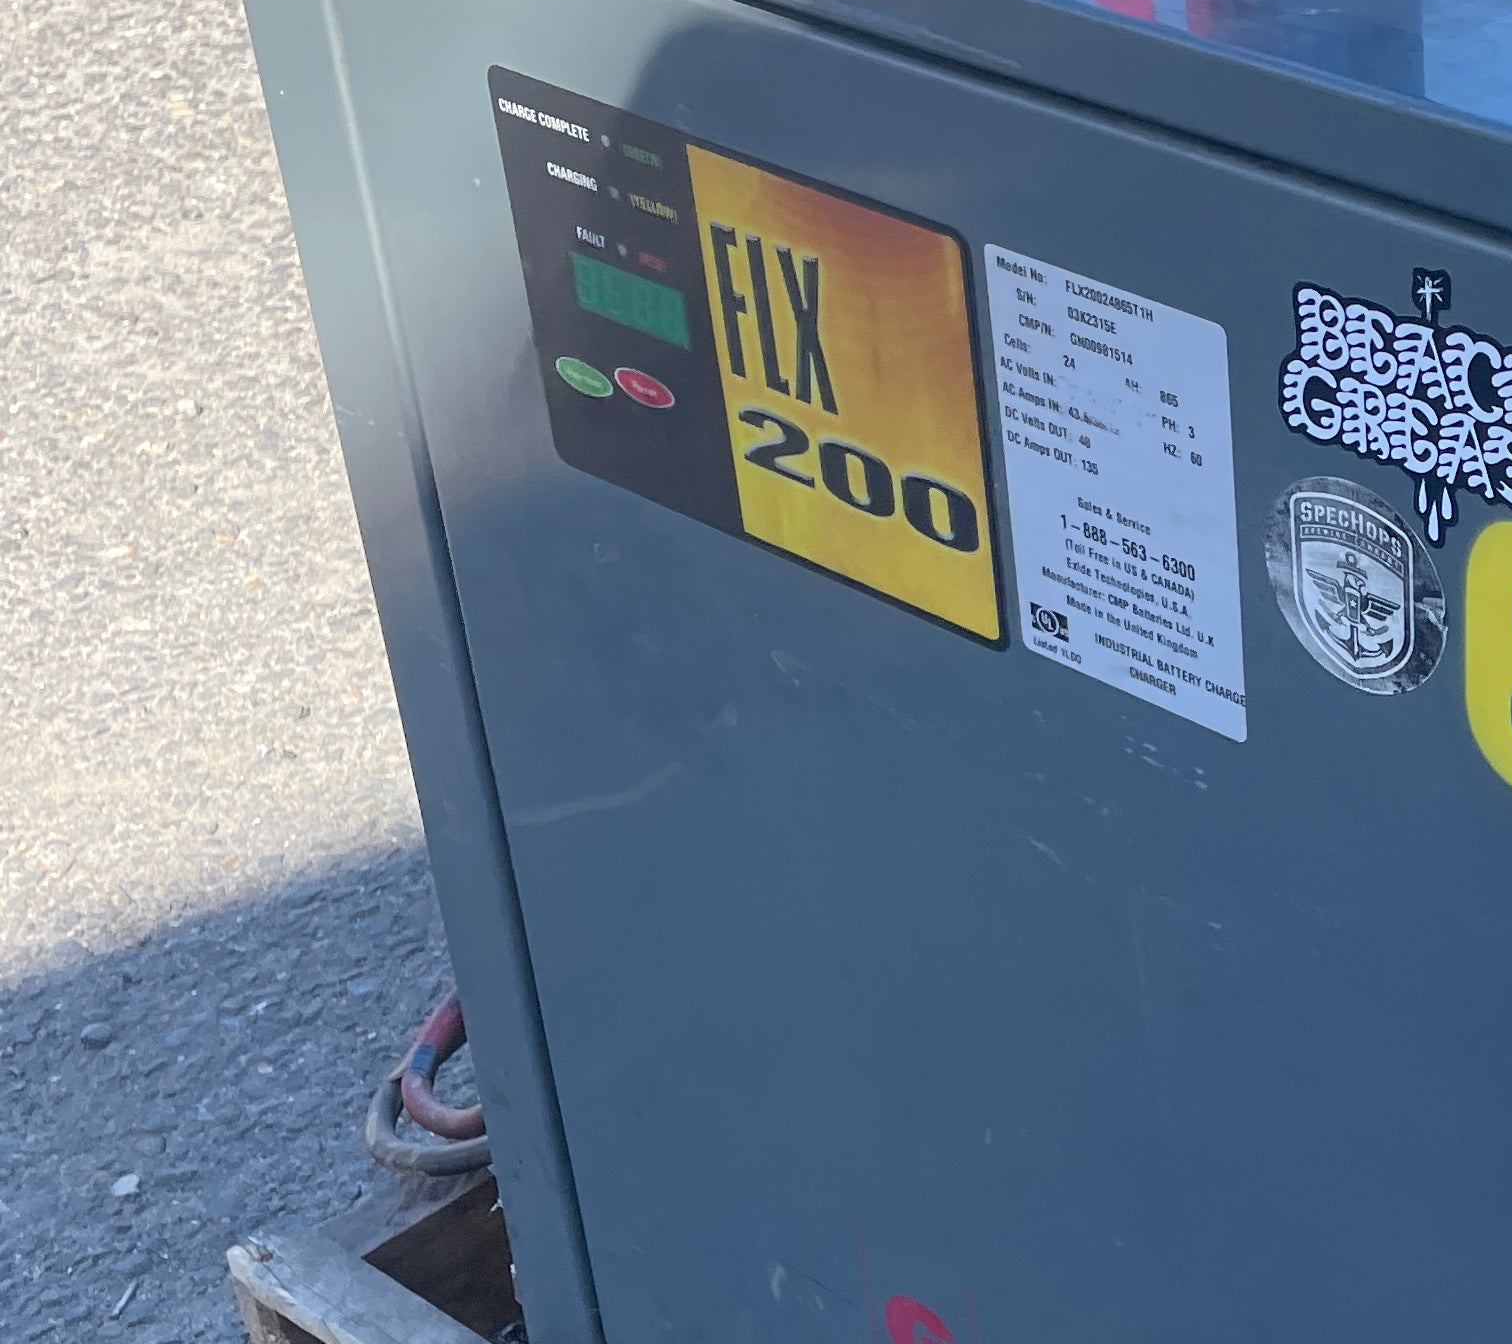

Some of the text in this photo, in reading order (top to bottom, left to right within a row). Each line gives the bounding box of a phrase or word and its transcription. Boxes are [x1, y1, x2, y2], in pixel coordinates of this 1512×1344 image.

[498, 97, 537, 123] CHARGE
[538, 112, 590, 143] COMPLETE
[546, 161, 598, 192] CHARGING
[576, 225, 605, 249] FAULT
[996, 255, 1027, 277] Model
[1016, 287, 1037, 306] S/N:
[710, 220, 839, 416] FLX
[1004, 333, 1031, 353] Cells:
[1062, 354, 1076, 370] 24
[1000, 355, 1014, 371] AC
[1016, 361, 1040, 381] Volts
[1188, 425, 1196, 439] 3
[1002, 381, 1016, 396] AC
[1019, 387, 1046, 407] Amps
[1190, 451, 1203, 467] 60
[1005, 405, 1019, 421] DC
[1021, 411, 1046, 431] Volts
[1007, 429, 1021, 445] DC
[1024, 436, 1051, 457] Amps
[738, 405, 980, 554] 200
[1077, 496, 1151, 536] Sales & Service
[1066, 556, 1092, 578] Exide
[1088, 547, 1109, 566] Free
[1123, 561, 1138, 577] US
[1141, 568, 1149, 582] &
[1150, 573, 1196, 603] CANADA)
[1066, 594, 1199, 659] Made in the United Kingdom
[1094, 632, 1154, 667] INDUSTRIAL
[1156, 658, 1202, 688] BATTERY
[1129, 666, 1177, 696] CHARGER
